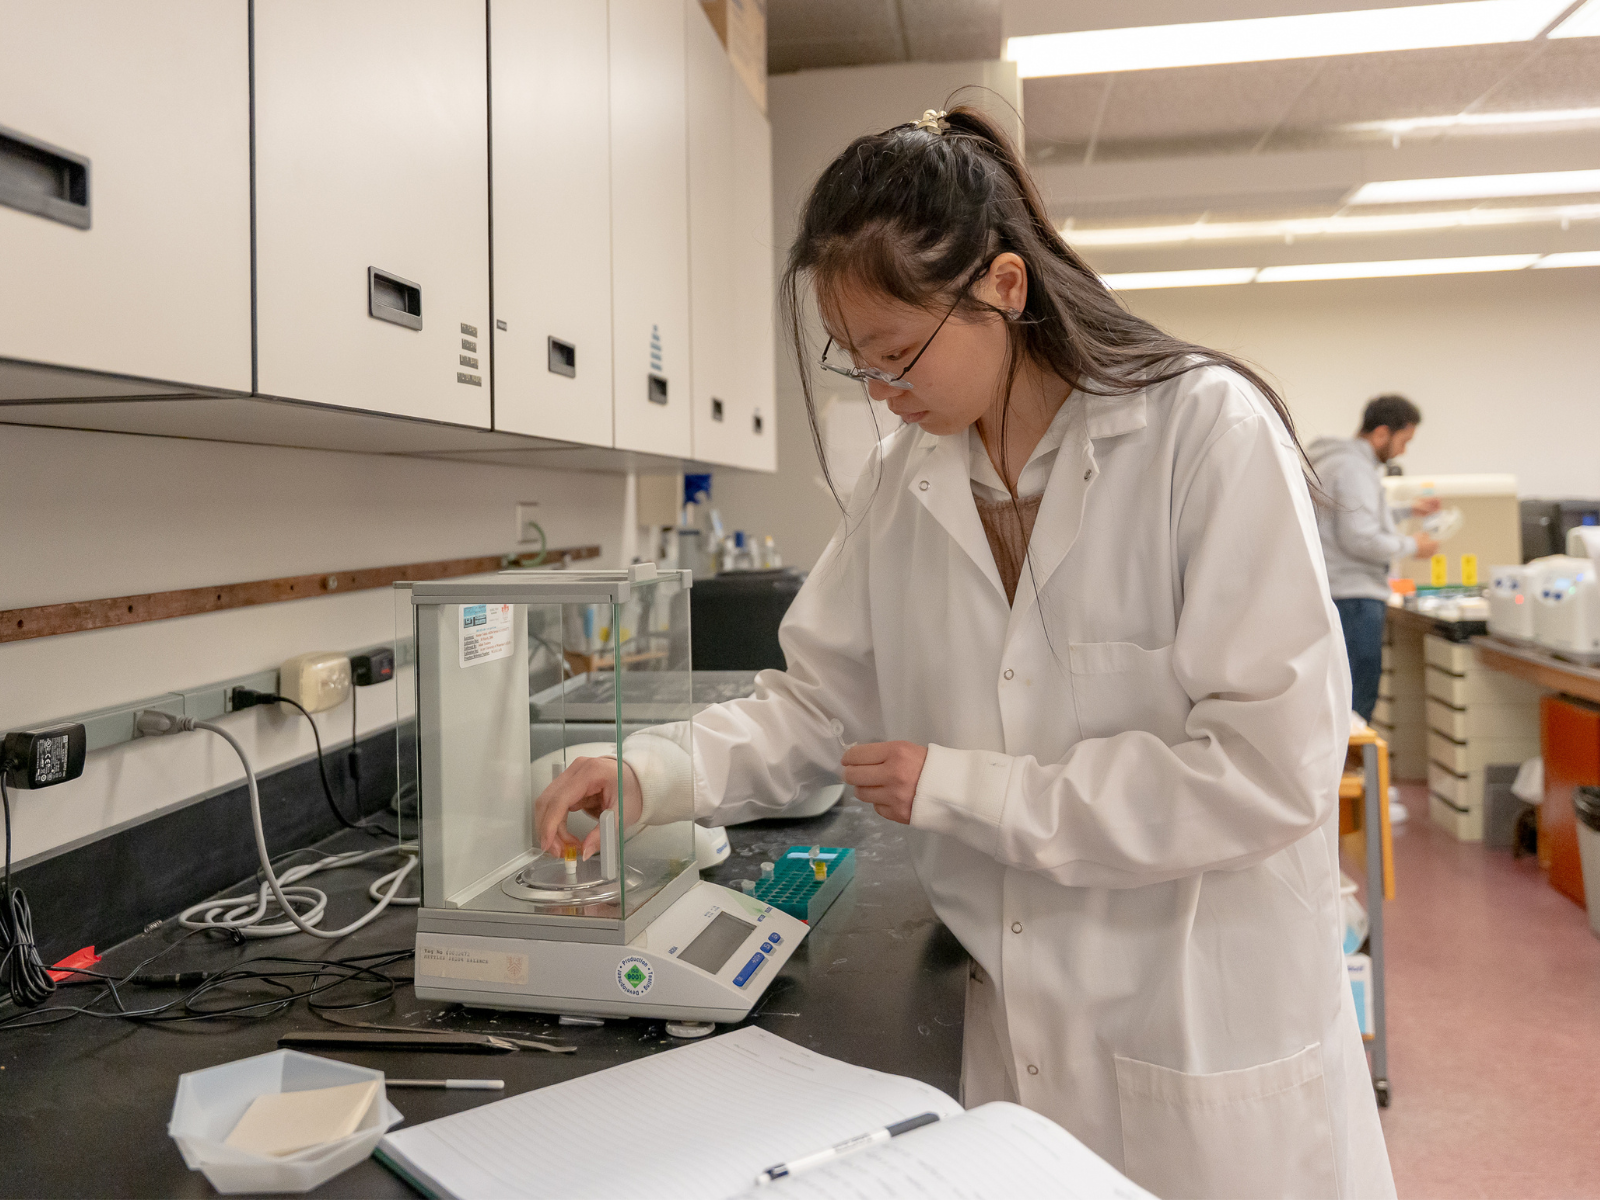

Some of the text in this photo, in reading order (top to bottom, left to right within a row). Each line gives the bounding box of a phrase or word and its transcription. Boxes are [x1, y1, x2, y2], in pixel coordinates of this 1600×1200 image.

[622, 956, 648, 967] Production
[617, 969, 640, 996] Development
[643, 971, 653, 990] Testing
